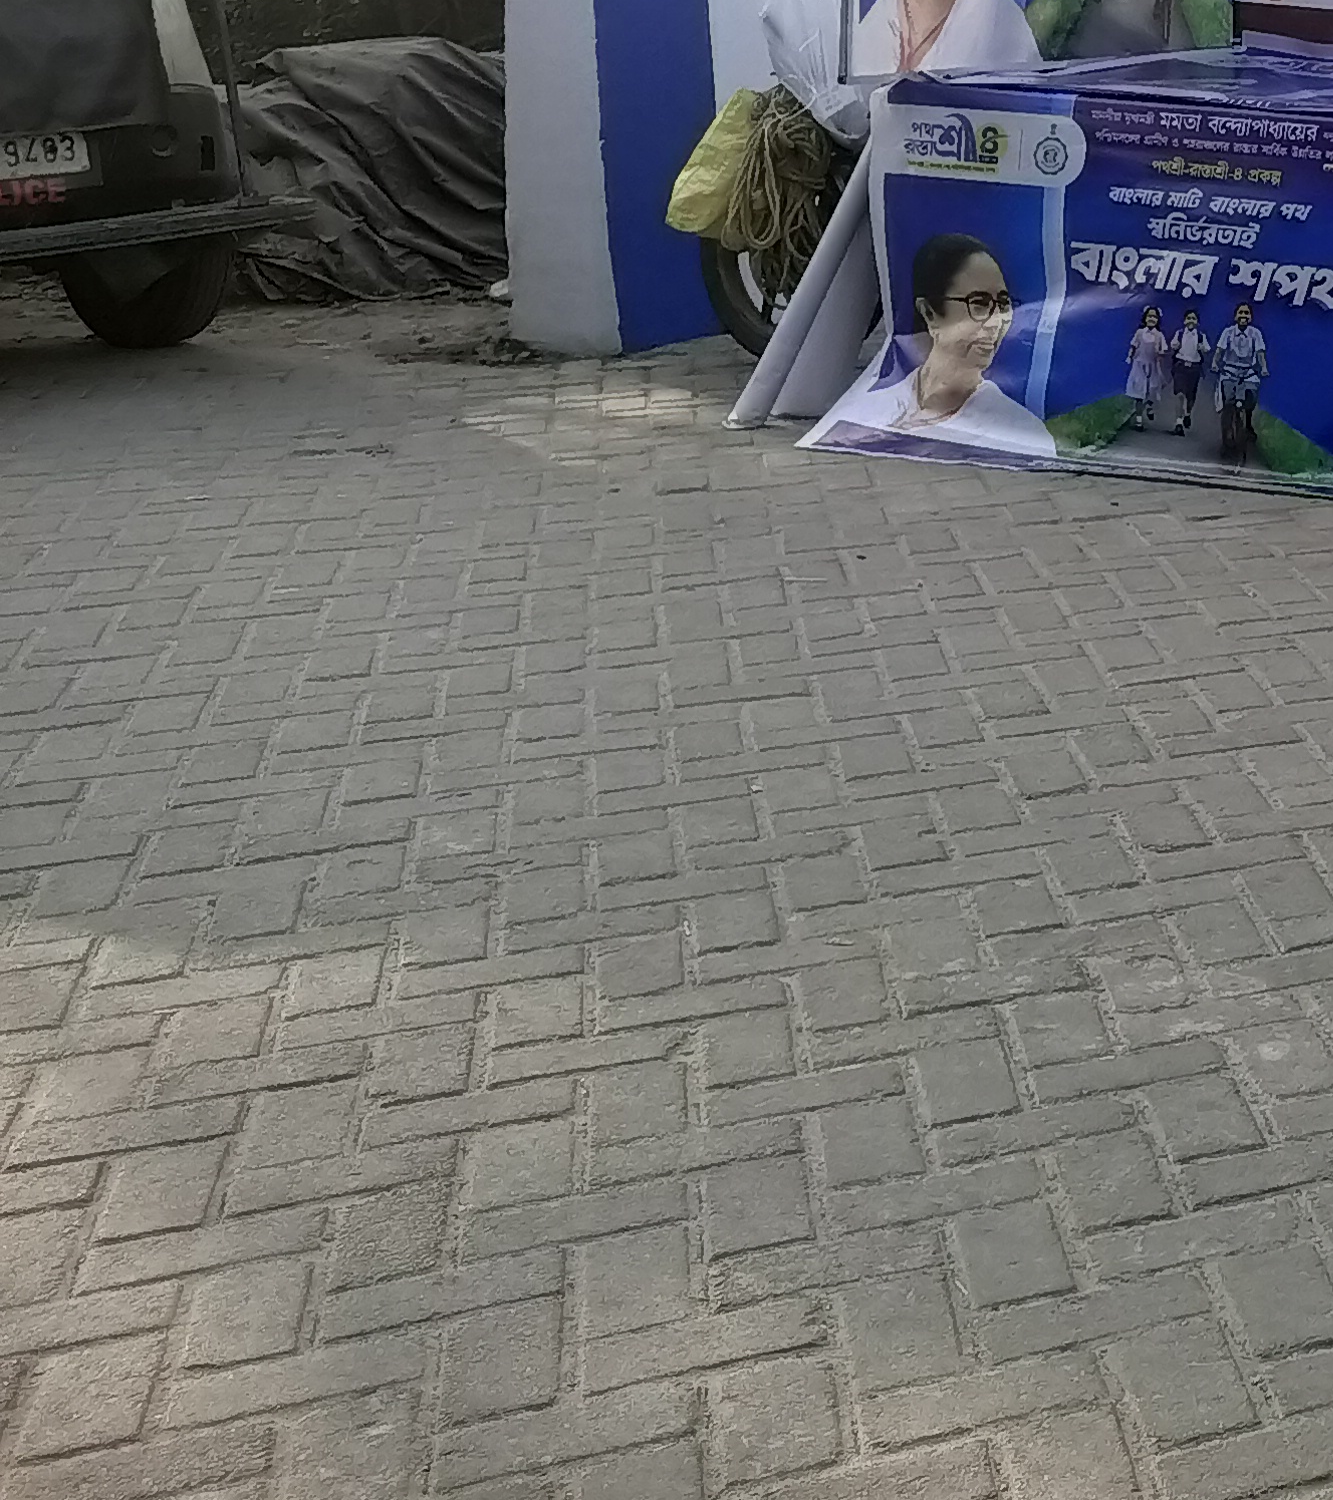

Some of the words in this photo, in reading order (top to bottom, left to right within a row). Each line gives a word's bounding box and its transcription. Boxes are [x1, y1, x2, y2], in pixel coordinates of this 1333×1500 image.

[1159, 112, 1202, 133] মমতা
[1207, 115, 1319, 142] বন্দ্যোপাধ্যায়ের
[1109, 186, 1162, 209] বাংলার
[1166, 187, 1203, 209] মাটি
[1208, 195, 1276, 218] বাংলার
[1279, 202, 1313, 221] পথ
[1147, 212, 1261, 248] স্বনির্ভরতাই
[1070, 241, 1219, 298] বাংলার
